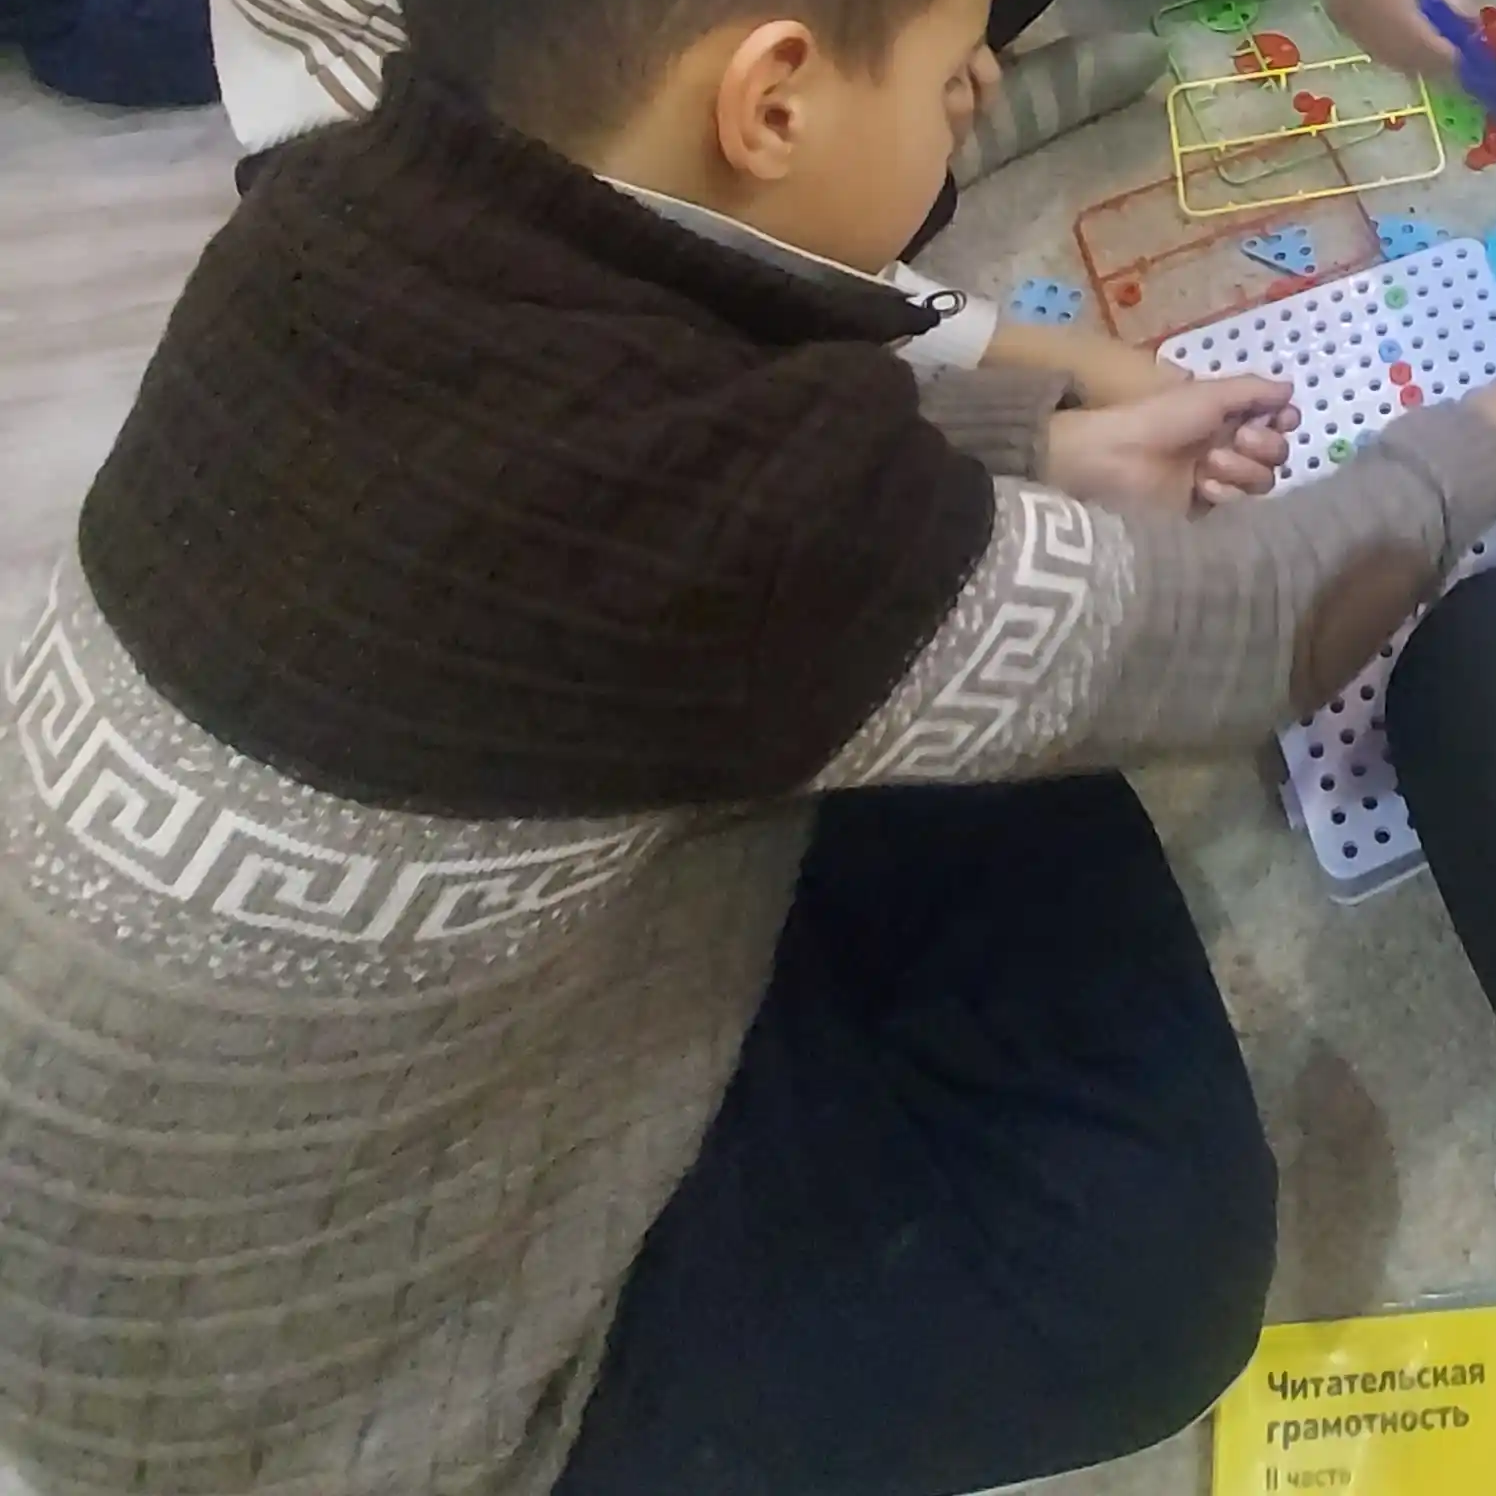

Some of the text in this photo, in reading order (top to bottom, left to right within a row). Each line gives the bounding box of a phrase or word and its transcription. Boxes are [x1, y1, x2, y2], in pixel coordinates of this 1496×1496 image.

[1267, 1363, 1485, 1401] Читательская
[1266, 1406, 1470, 1450] грамотность
[1287, 1467, 1352, 1488] часть
